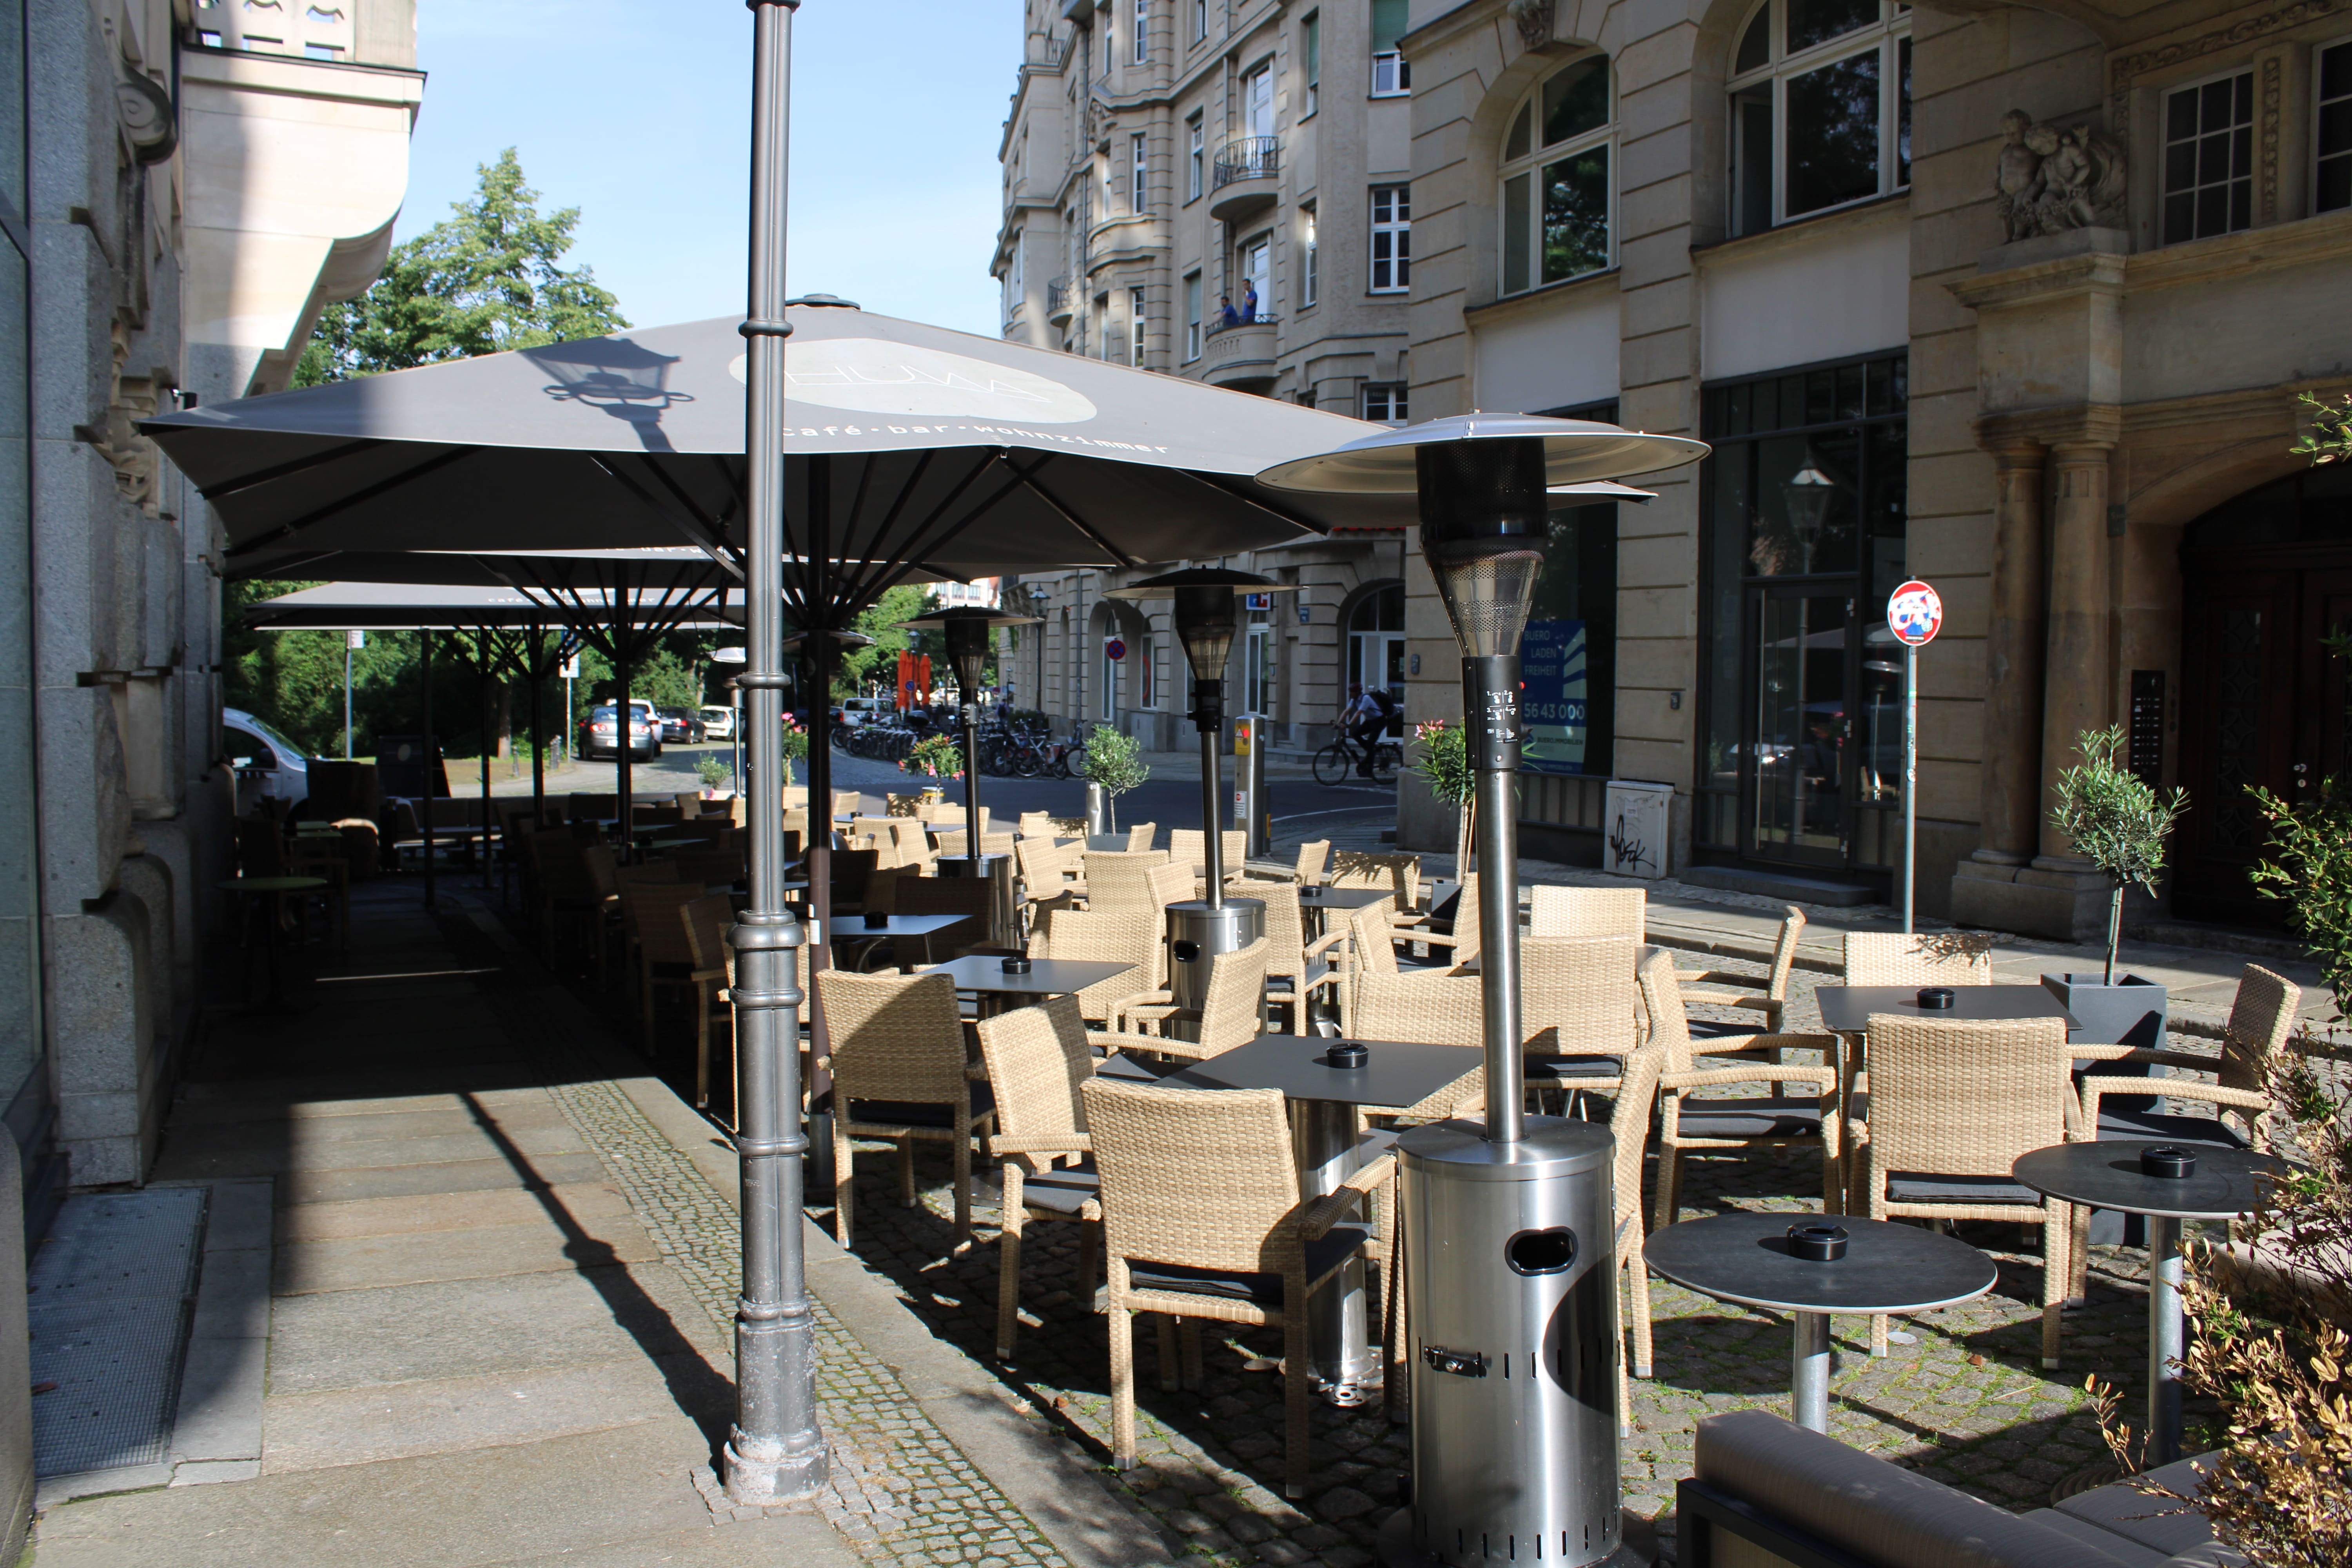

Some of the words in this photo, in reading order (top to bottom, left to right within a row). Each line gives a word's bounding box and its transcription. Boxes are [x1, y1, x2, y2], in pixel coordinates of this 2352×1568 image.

[887, 425, 949, 434] bar
[973, 425, 1168, 454] wohnzimmer
[1524, 630, 1550, 641] BUERO
[1531, 648, 1557, 659] LADEN
[1524, 665, 1557, 676] FREIHEIT
[1524, 702, 1539, 718] 56
[1541, 703, 1555, 719] 43
[1559, 704, 1585, 720] 000
